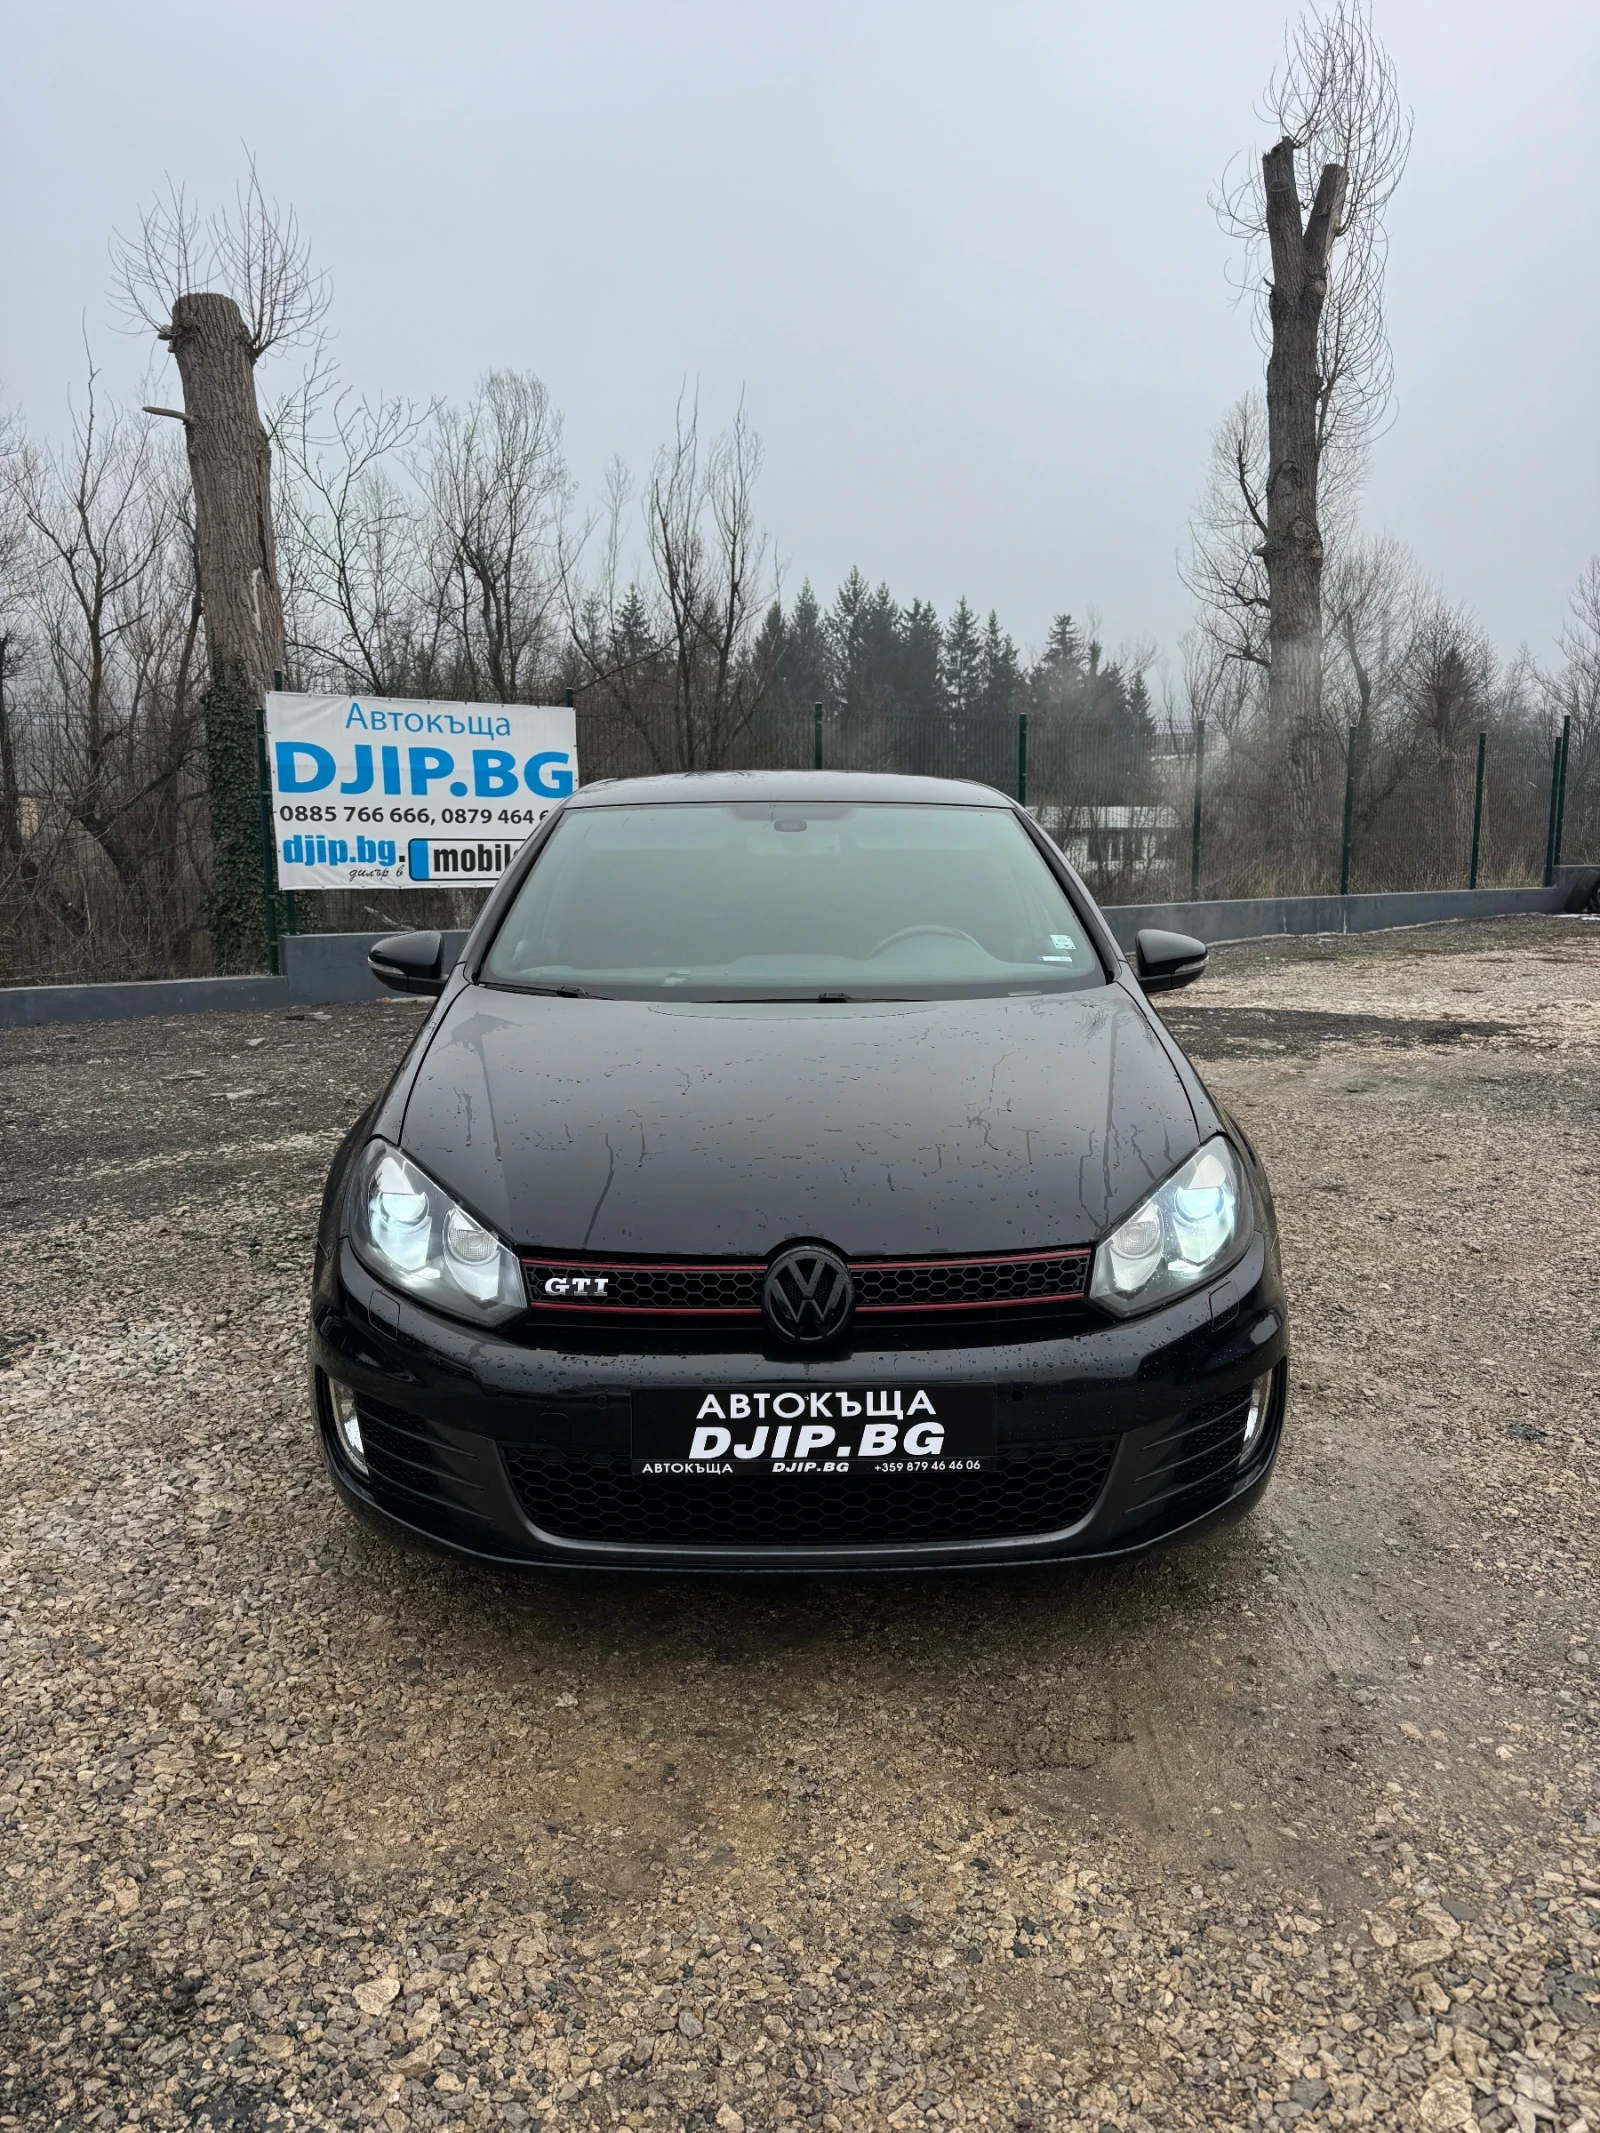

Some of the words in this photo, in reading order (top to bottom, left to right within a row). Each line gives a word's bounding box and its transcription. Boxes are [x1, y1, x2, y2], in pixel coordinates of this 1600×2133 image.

[345, 702, 511, 740] Автокъща
[275, 741, 574, 799] DJIP.BG
[280, 805, 337, 822] 0885
[343, 806, 384, 822] 766
[389, 807, 436, 826] 666,
[441, 808, 493, 824] 0879
[498, 809, 535, 824] 464
[544, 1277, 609, 1297] GTI
[696, 1390, 937, 1420] АВТОКЪЩА
[688, 1421, 945, 1459] DJIP.BG
[642, 1462, 733, 1475] АВТОКЪЩА
[772, 1462, 850, 1473] DJIP.BG
[874, 1461, 904, 1473] +359
[906, 1461, 929, 1472] 879
[931, 1461, 948, 1472] 46
[949, 1460, 965, 1472] 46
[966, 1460, 981, 1471] 06
